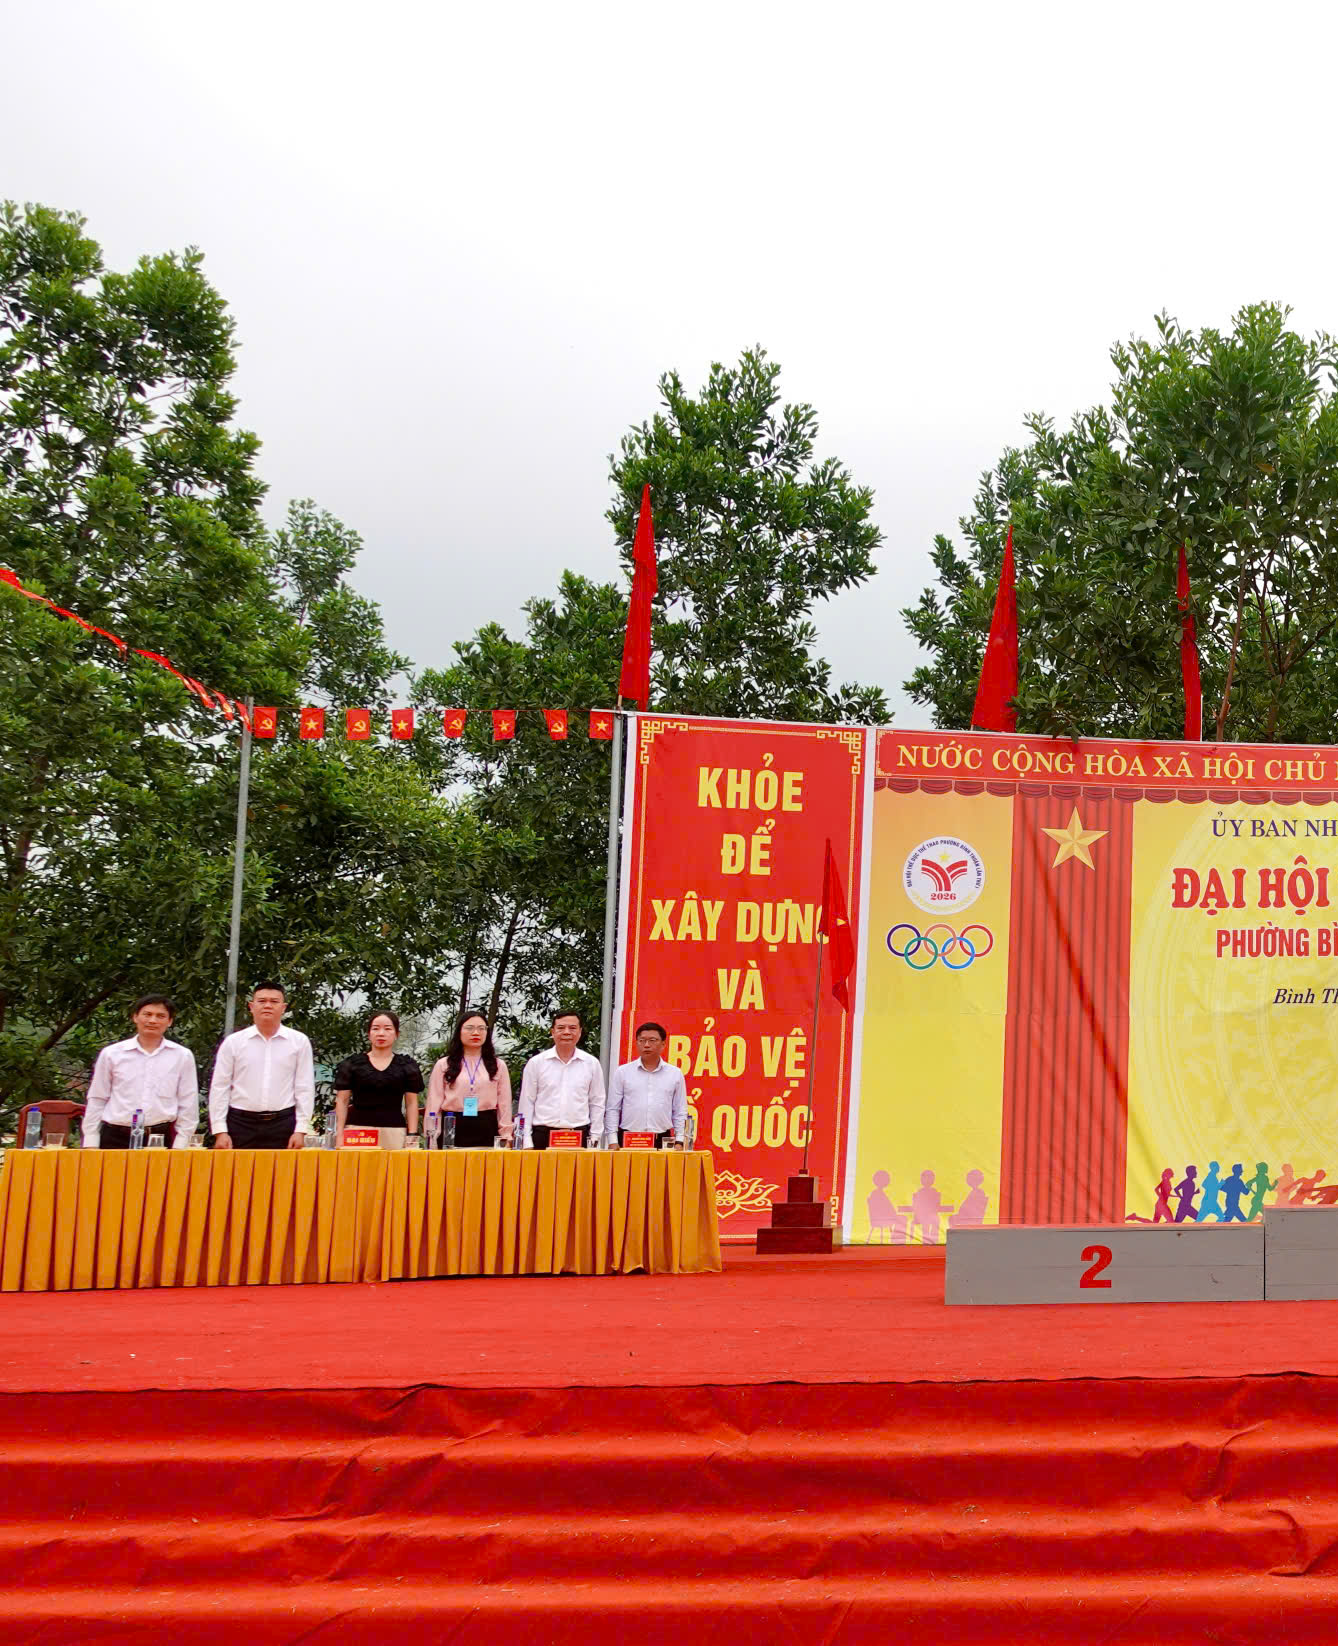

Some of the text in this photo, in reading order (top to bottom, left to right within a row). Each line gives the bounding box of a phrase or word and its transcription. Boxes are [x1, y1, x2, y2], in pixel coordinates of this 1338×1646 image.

[697, 752, 804, 812] KHỎE
[897, 740, 982, 770] NƯỚC
[992, 743, 1074, 777] CỘNG
[1086, 748, 1145, 777] HÒA
[1153, 751, 1193, 777] XÃ
[1203, 751, 1256, 785] HỘI
[1264, 749, 1326, 781] CHỦ
[720, 818, 776, 876] ĐỂ
[1212, 811, 1244, 838] ỦY
[1250, 819, 1298, 837] BAN
[930, 893, 957, 901] 2026
[1171, 867, 1247, 916] ĐẠI
[1257, 855, 1330, 916] HỘI
[648, 890, 725, 942] XÂY
[1216, 921, 1309, 958] PHƯỜNG
[717, 959, 765, 1011] VÀ
[1272, 986, 1315, 1005] Bình
[667, 1016, 807, 1088] BẢO VỆ
[710, 1088, 814, 1153] QUỐC
[1079, 1245, 1113, 1289] 2
